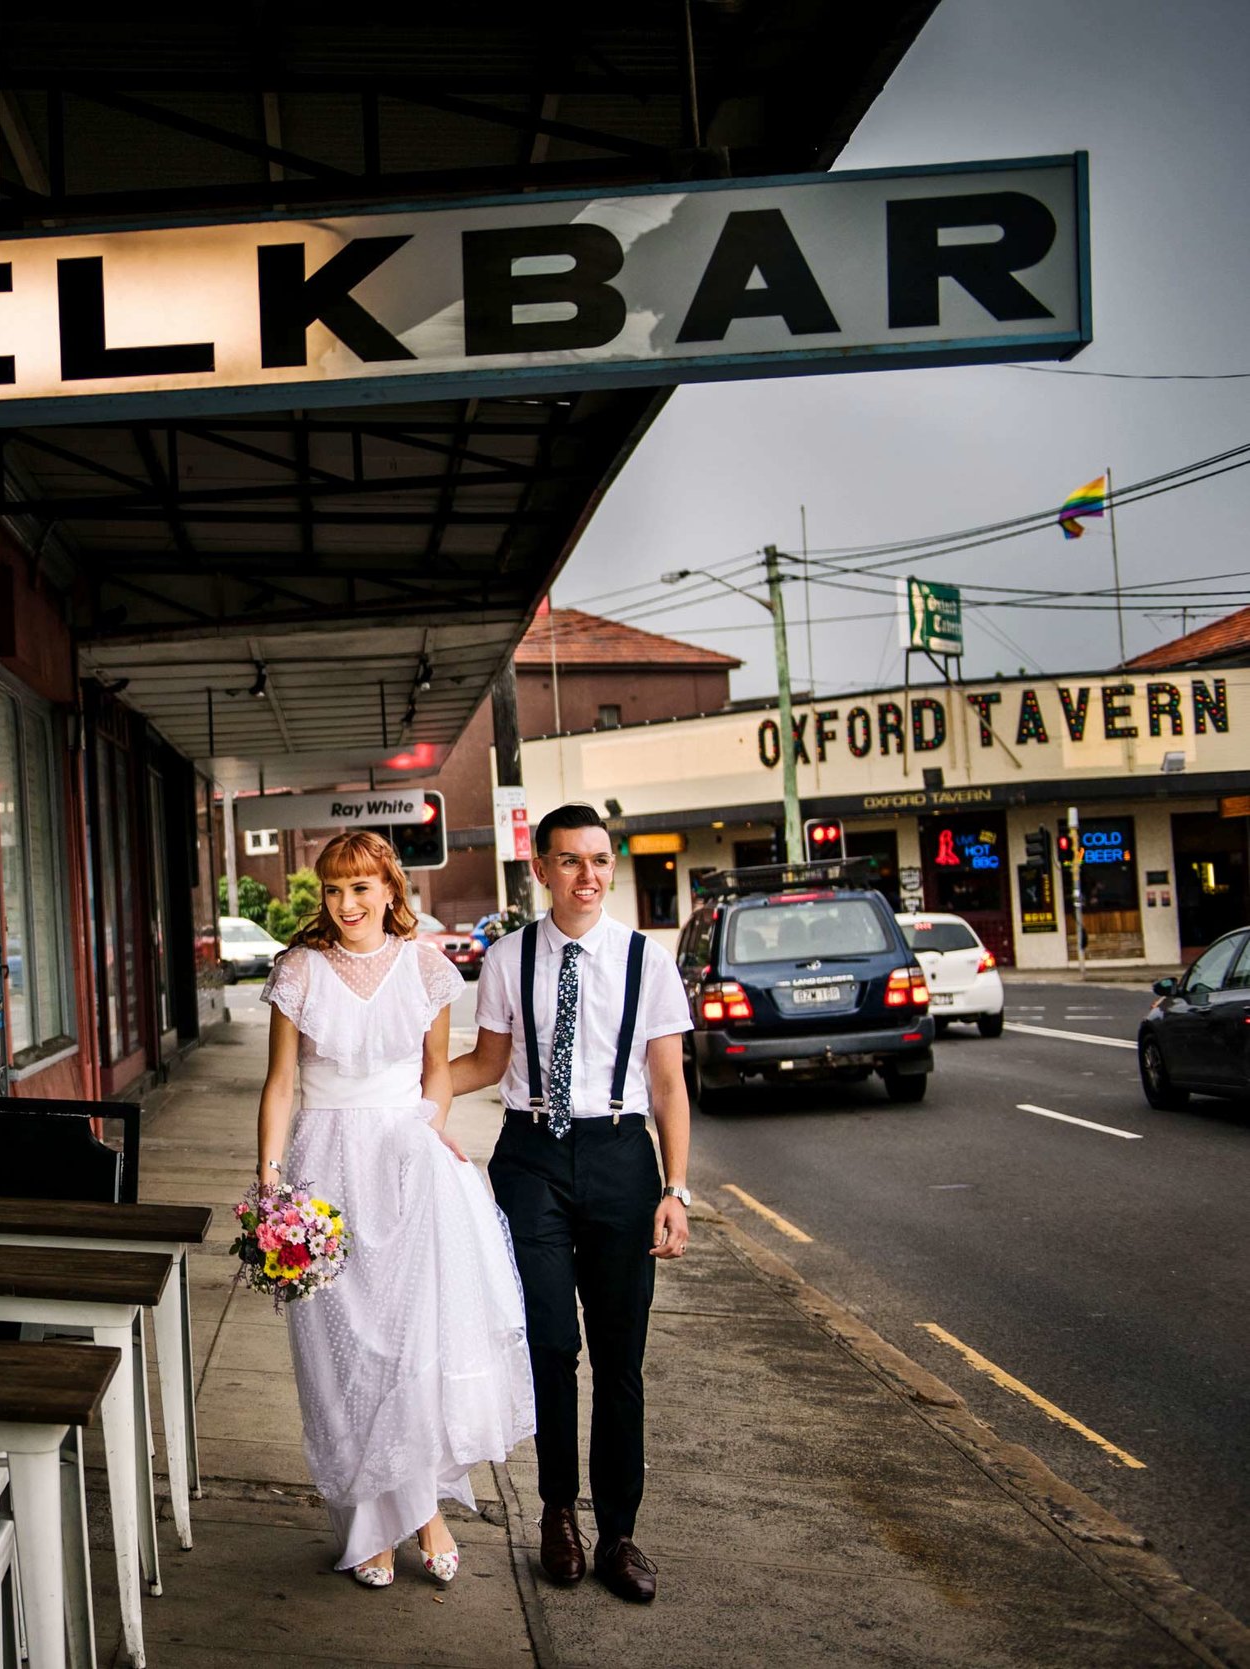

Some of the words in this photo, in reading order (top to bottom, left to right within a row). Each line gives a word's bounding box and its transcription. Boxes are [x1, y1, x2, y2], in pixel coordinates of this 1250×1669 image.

[758, 697, 946, 769] OXFORD
[967, 678, 1229, 747] TAVERN
[863, 793, 926, 809] OXFORD
[931, 789, 991, 804] TAVERN
[331, 802, 363, 818] Ray
[366, 800, 414, 815] White
[1082, 831, 1122, 846] COLD
[965, 844, 991, 857] HOT
[1084, 848, 1123, 864] BEER
